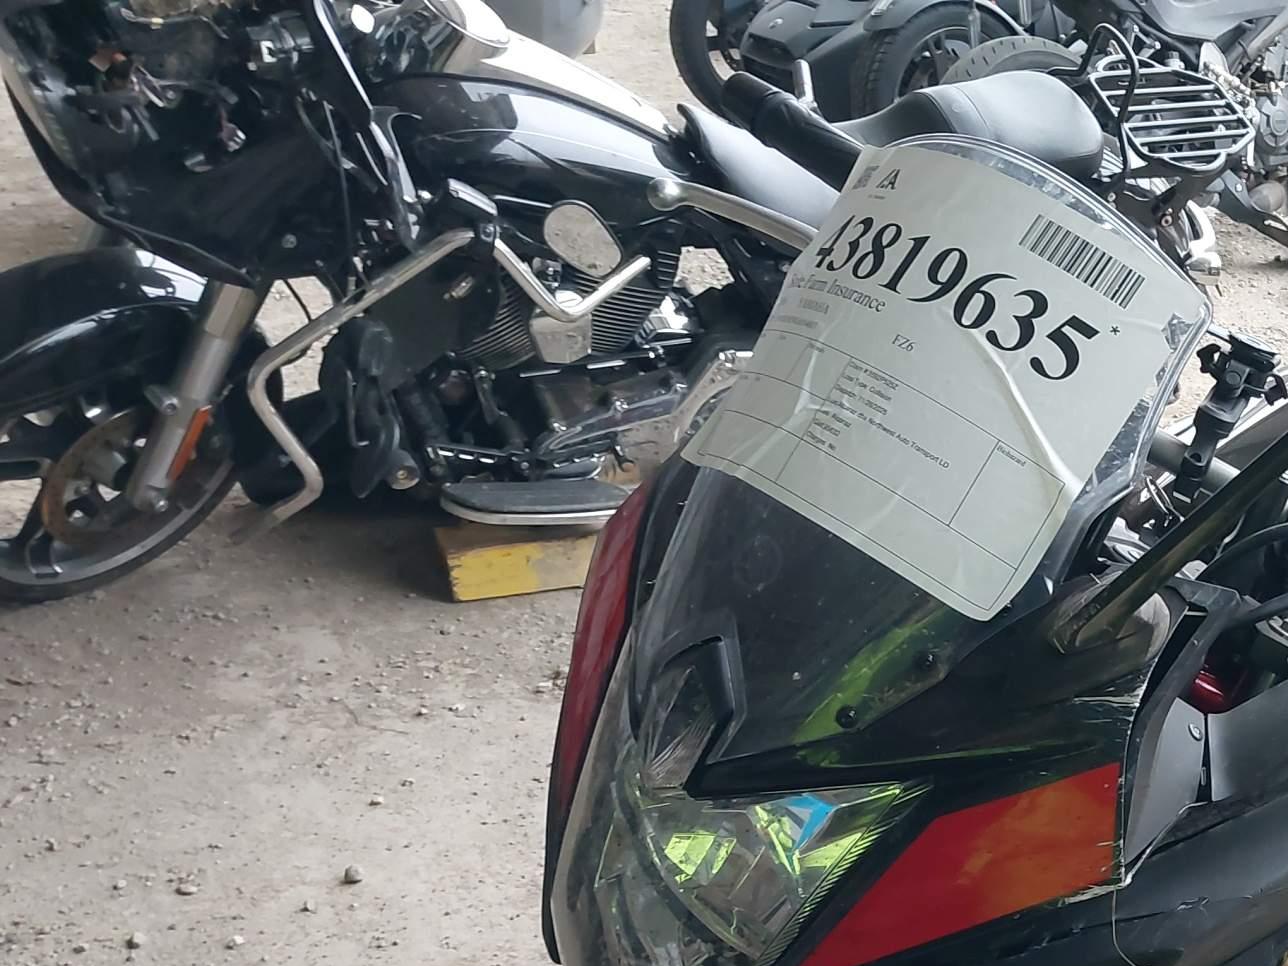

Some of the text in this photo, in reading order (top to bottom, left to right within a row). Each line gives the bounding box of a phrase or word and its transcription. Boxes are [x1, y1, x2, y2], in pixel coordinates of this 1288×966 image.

[816, 214, 1100, 381] 43819635
[827, 278, 886, 312] Insurance
[892, 334, 916, 352] FZ6
[868, 418, 896, 437] Northwest
[896, 434, 910, 445] Auto
[910, 441, 939, 462] Transport
